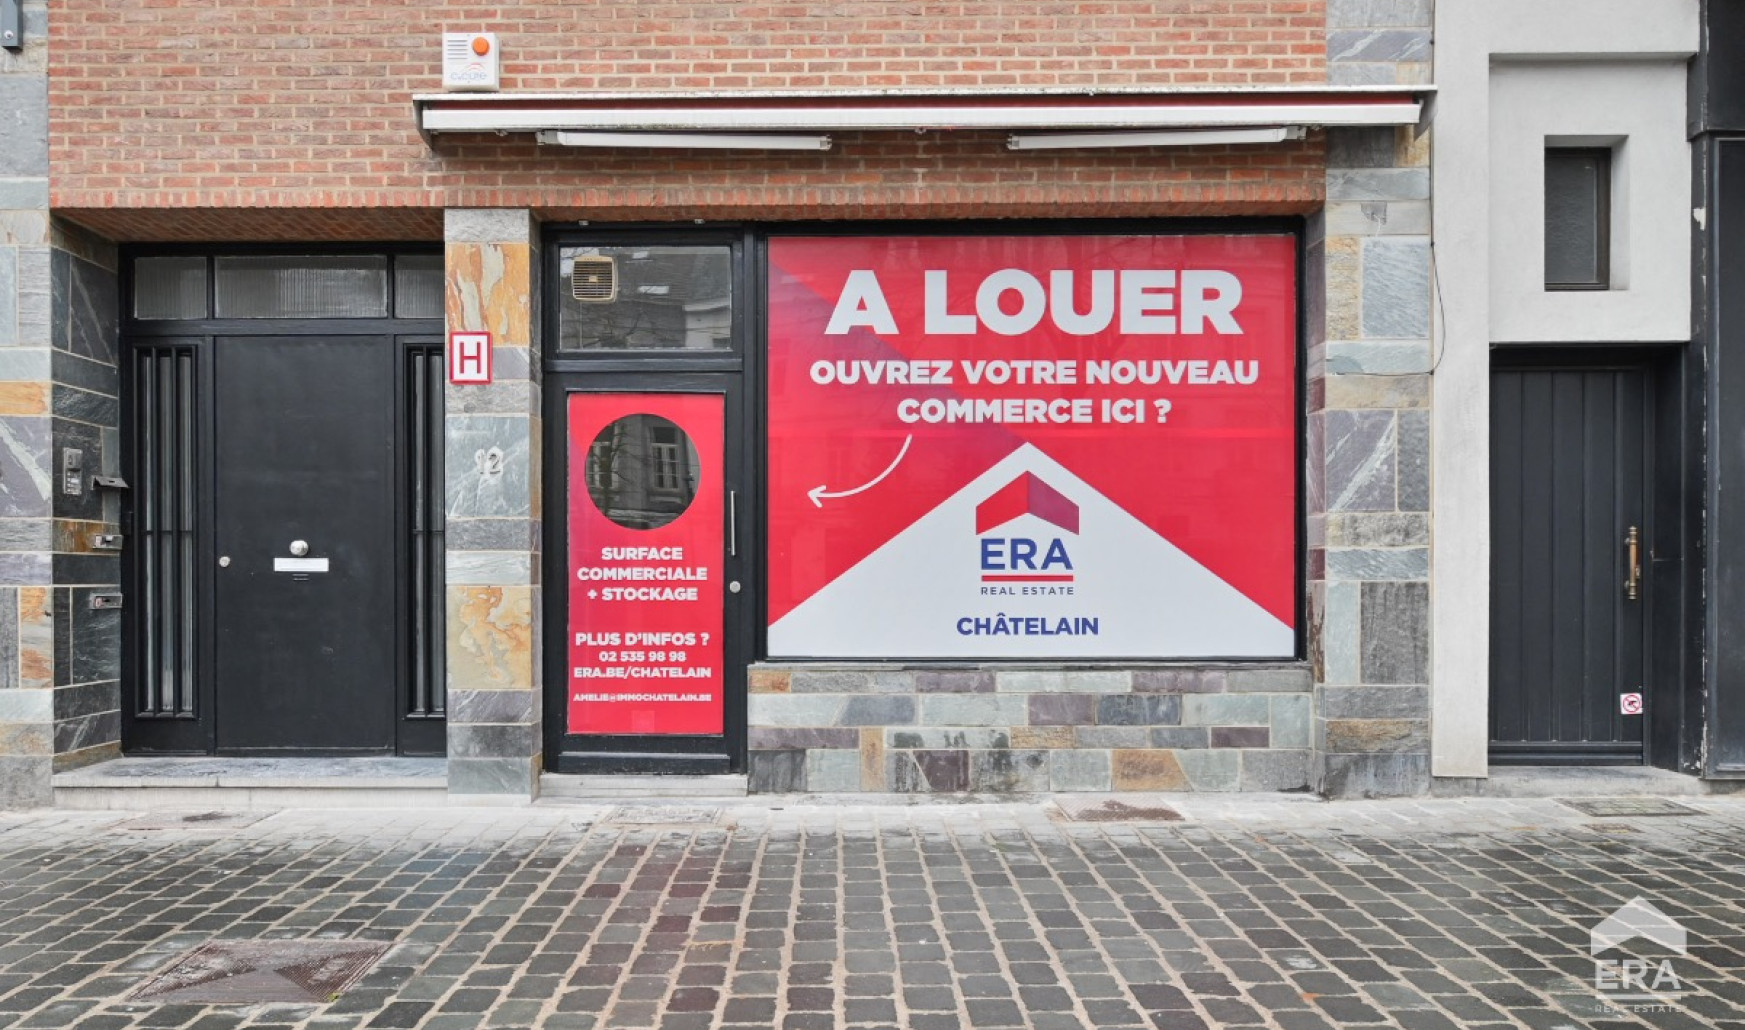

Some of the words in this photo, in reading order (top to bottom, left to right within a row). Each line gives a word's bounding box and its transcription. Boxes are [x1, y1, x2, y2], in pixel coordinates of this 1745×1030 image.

[824, 270, 899, 334] A
[924, 268, 1243, 336] LOUER
[459, 341, 481, 374] H
[810, 360, 954, 385] OUVREZ
[961, 360, 1077, 385] VOTRE
[1086, 360, 1259, 385] NOUVEAU
[897, 398, 1093, 424] COMMERCE
[1102, 398, 1145, 424] ICI
[1153, 398, 1173, 424] ?
[601, 546, 683, 561] SURFACE
[981, 538, 1073, 571] ERA
[577, 566, 708, 581] COMMERCIALE
[587, 589, 597, 600] +
[601, 587, 698, 601] STOCKAGE
[981, 586, 1015, 596] REAL
[1021, 586, 1074, 596] ESTATE
[957, 613, 1099, 636] CHÂTELAIN
[575, 632, 622, 646] PLUS
[624, 632, 696, 646] D’INFOS
[700, 632, 710, 646] ?
[599, 651, 617, 662] 02
[620, 651, 645, 662] 535
[648, 651, 666, 662] 98
[669, 651, 687, 662] 98
[573, 666, 712, 679] ERA.BE/CHATELAIN
[573, 693, 712, 702] AMELIE@IMMOCHATELAIN.BE
